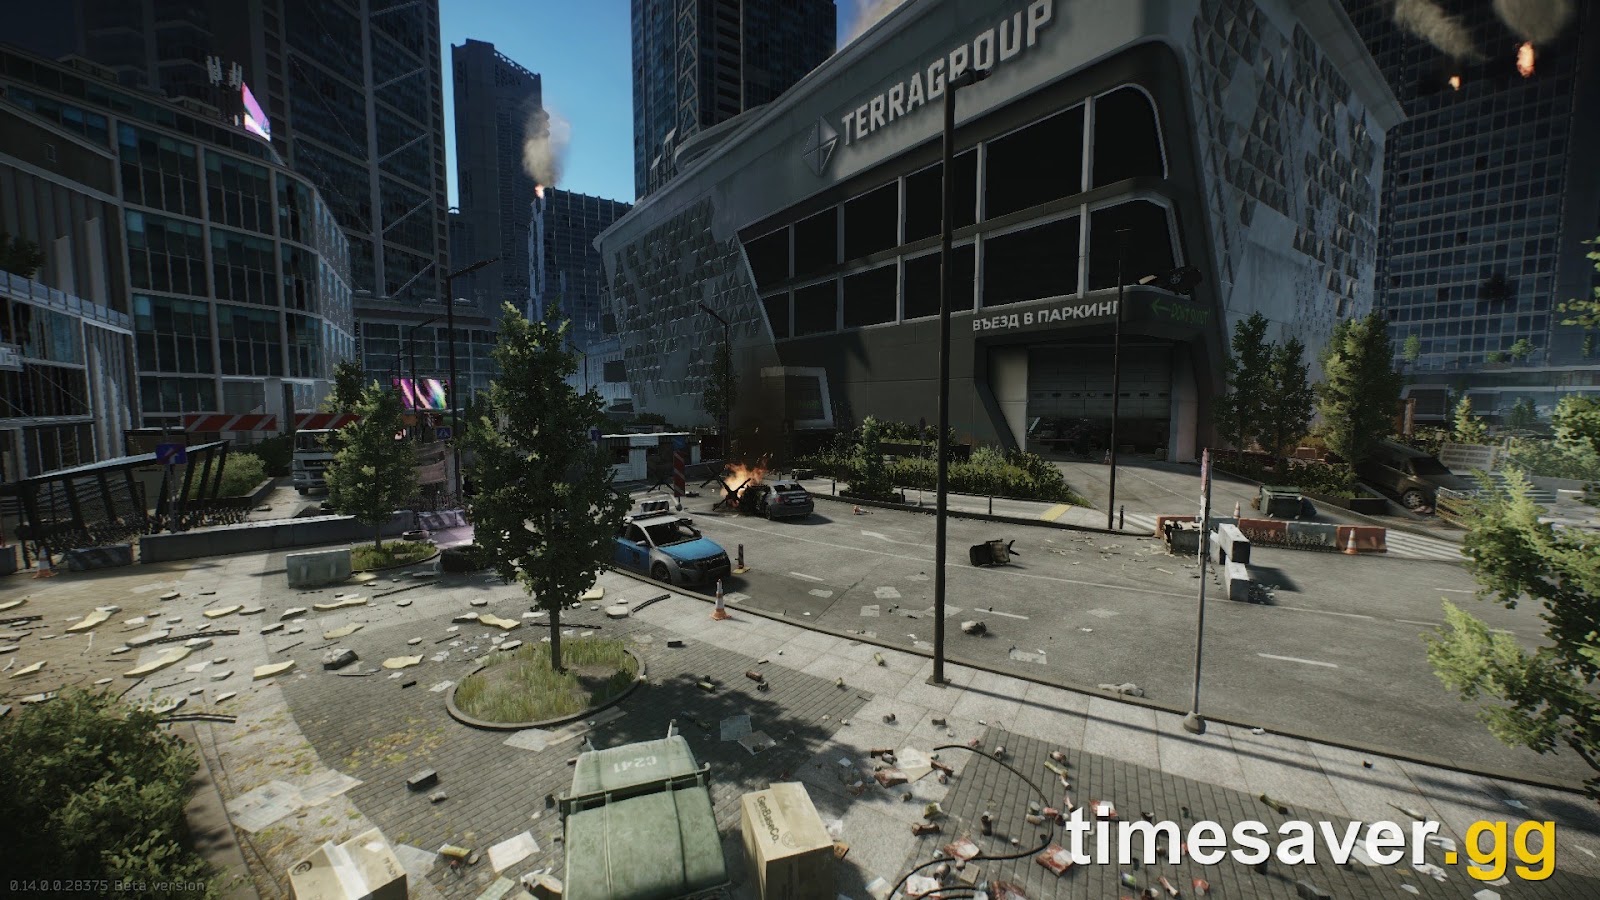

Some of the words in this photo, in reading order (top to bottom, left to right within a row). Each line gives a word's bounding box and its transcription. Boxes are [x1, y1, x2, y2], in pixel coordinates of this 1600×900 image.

[842, 0, 1053, 146] TERRAGROUP
[973, 314, 1019, 331] ВЪЕЗД
[1024, 312, 1034, 325] В
[613, 755, 657, 773] C241
